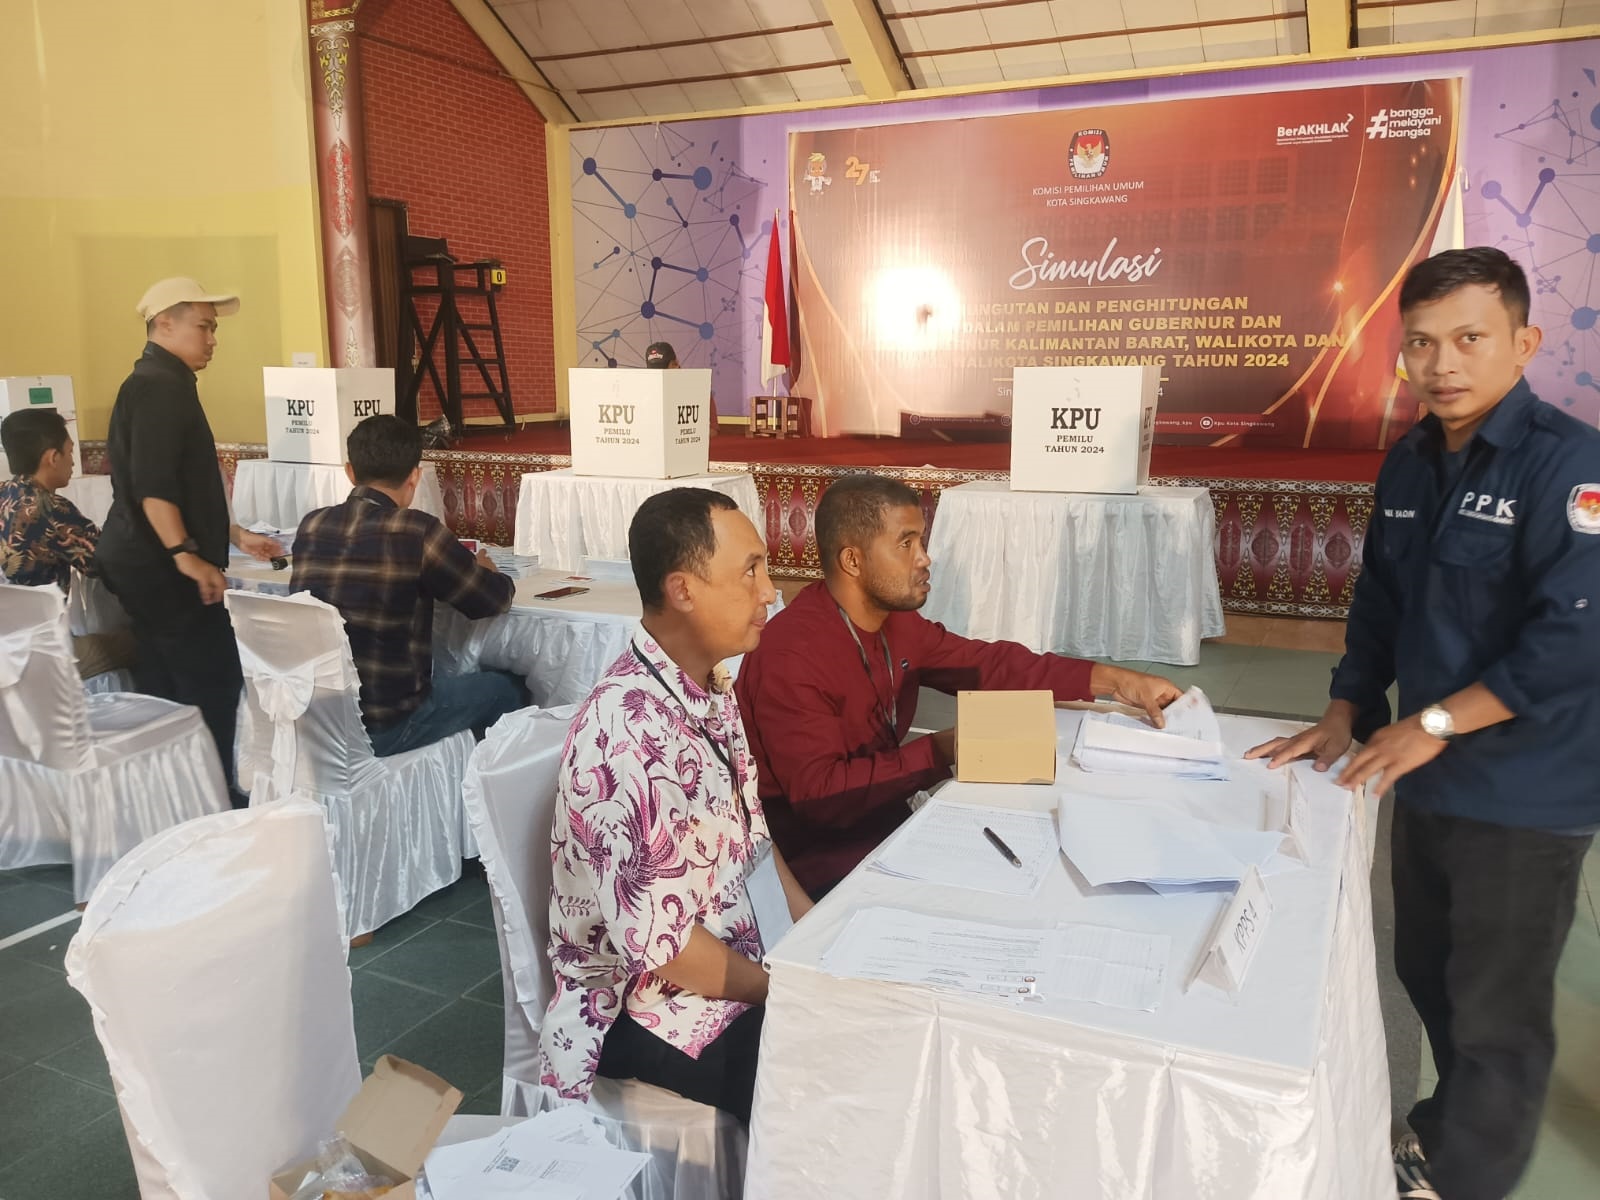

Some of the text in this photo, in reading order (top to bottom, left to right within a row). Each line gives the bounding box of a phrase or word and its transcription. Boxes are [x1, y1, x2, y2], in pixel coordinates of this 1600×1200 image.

[1390, 108, 1434, 119] bangga
[1389, 115, 1442, 128] melayani
[1078, 129, 1103, 137] KOMISI
[1277, 121, 1350, 138] BerAKHLAK
[1388, 128, 1431, 140] bangsa
[1032, 180, 1145, 196] KOMISI PEMILIHAN UMUM
[1046, 194, 1129, 207] KOTA SINGKAWANG
[1008, 236, 1163, 290] Simulasi
[1055, 300, 1091, 314] DAN
[1096, 296, 1249, 313] PENGHITUNGAN
[1025, 318, 1123, 333] PEMILIHAN
[1128, 315, 1235, 331] GUBERNUR
[1241, 315, 1282, 329] DAN
[1005, 336, 1120, 351] KALIMANTAN
[1125, 335, 1190, 351] BARAT,
[1195, 334, 1298, 348] WALIKOTA
[1303, 334, 1345, 348] DAN
[1043, 353, 1167, 368] SINGKAWANG
[1172, 354, 1238, 367] TAHUN
[1243, 353, 1290, 367] 2024
[286, 399, 315, 417] KPU
[353, 399, 381, 417] KPU
[598, 404, 636, 425] KPU
[677, 404, 700, 425] KPU
[1050, 407, 1102, 430] KPU
[603, 427, 631, 435] PEMILU
[679, 428, 697, 436] PEMILU
[1056, 434, 1094, 443] PEMILU
[622, 437, 640, 445] 2024
[675, 436, 701, 445] TAHUN 2024
[1045, 445, 1105, 454] TAHUN 2024
[1460, 491, 1518, 518] PPK
